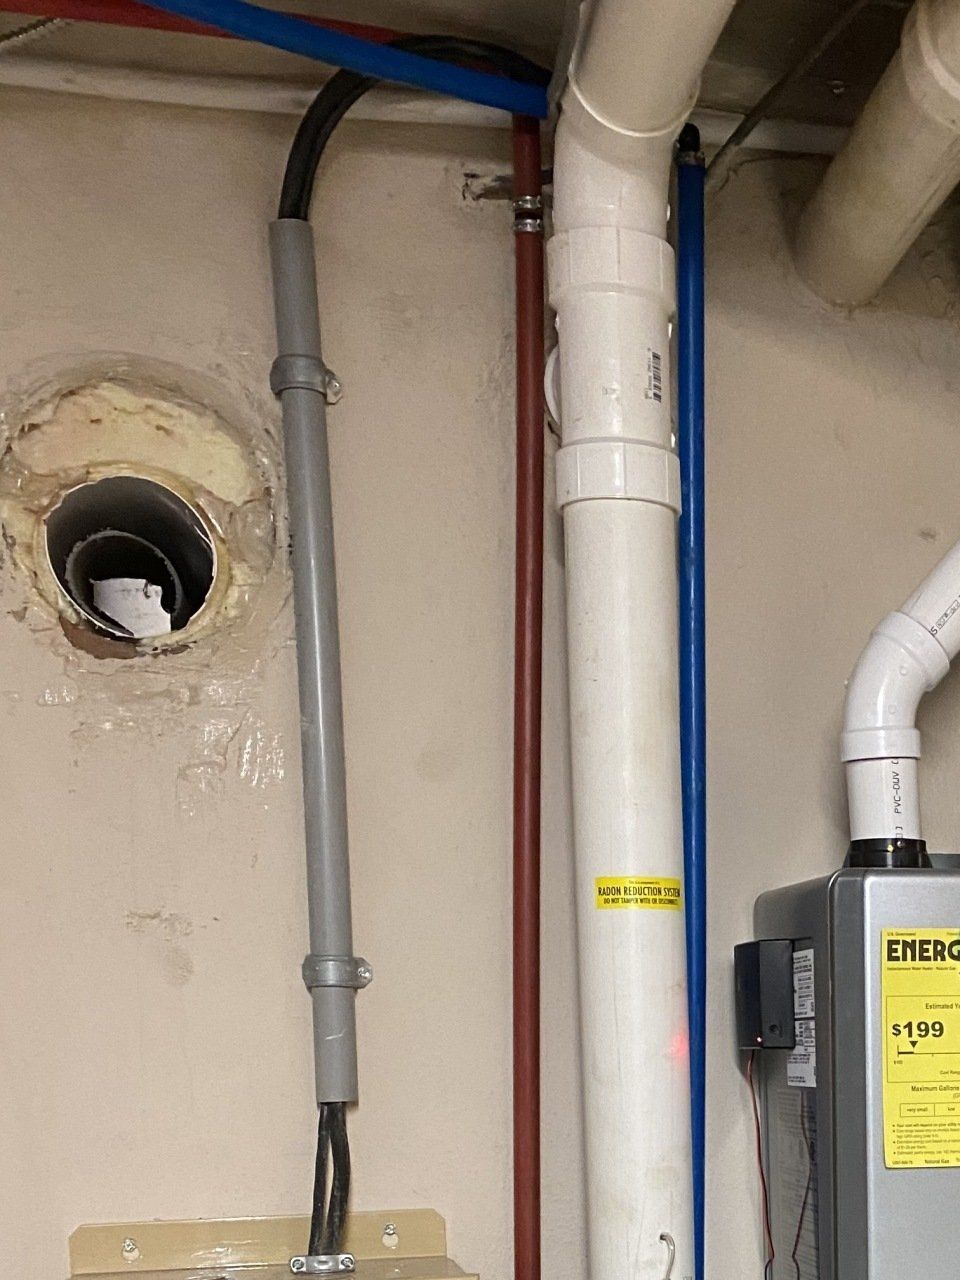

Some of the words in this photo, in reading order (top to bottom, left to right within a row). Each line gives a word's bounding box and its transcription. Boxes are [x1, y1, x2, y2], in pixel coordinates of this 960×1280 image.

[891, 771, 902, 814] PVC-DWV
[598, 886, 621, 896] RADON
[624, 886, 661, 896] REDUCTION
[891, 1020, 945, 1039] $199
